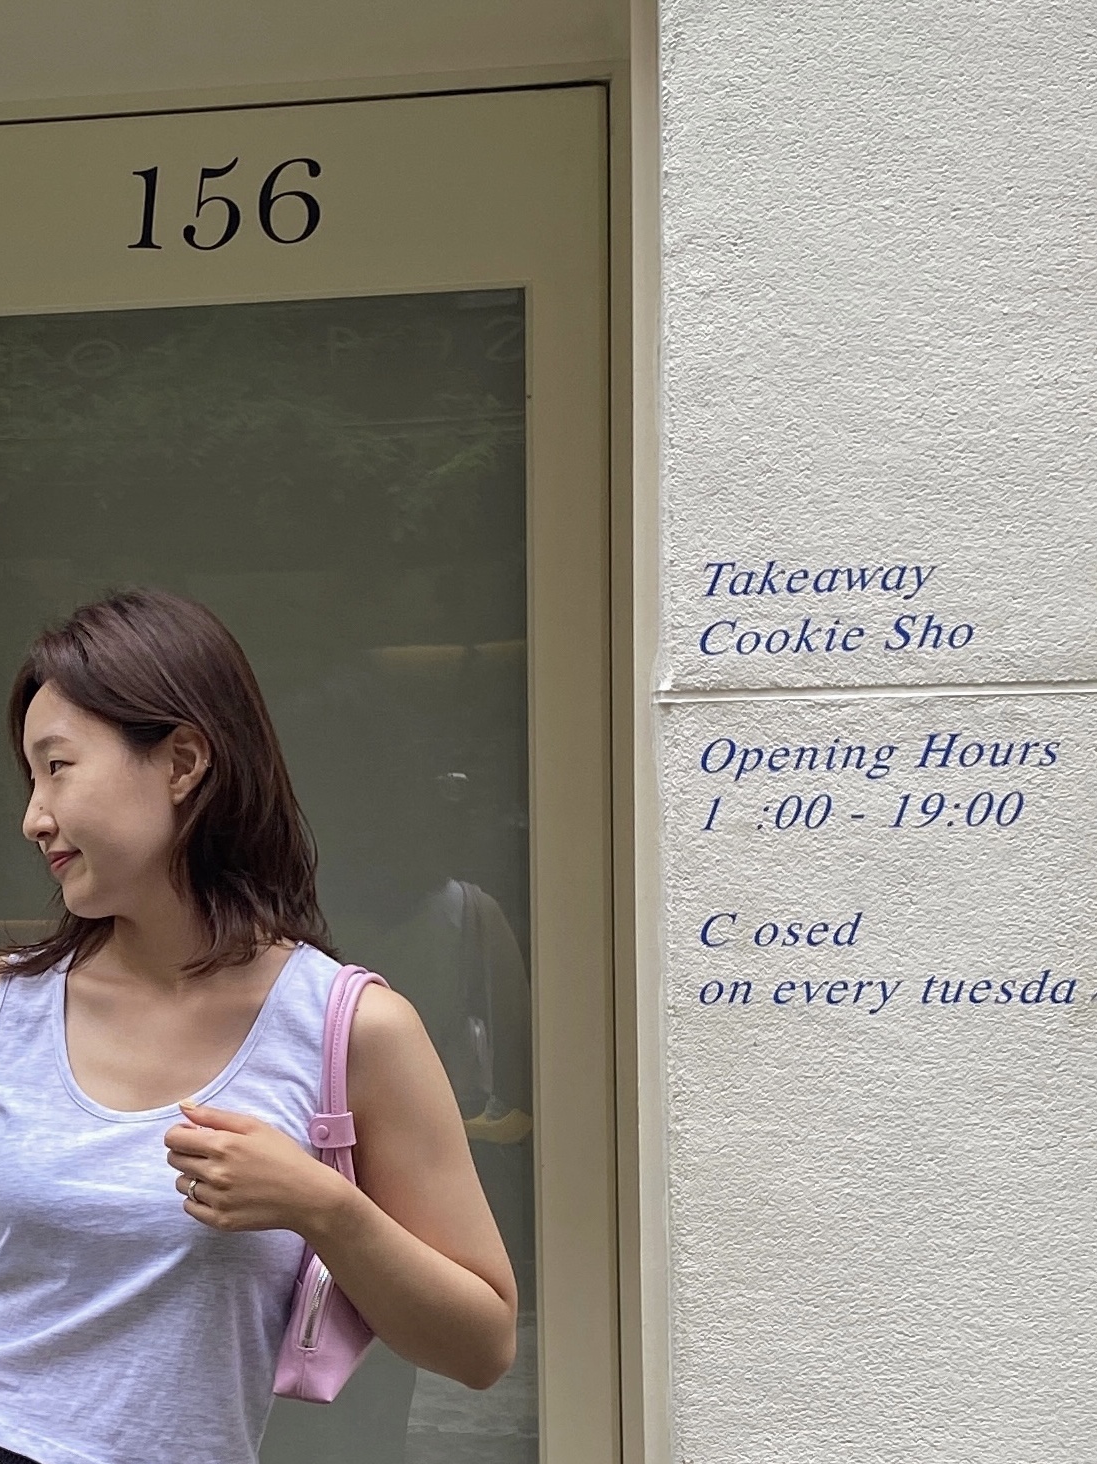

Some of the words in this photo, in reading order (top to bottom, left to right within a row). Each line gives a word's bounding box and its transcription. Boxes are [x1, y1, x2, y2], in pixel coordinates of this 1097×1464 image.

[127, 156, 322, 251] 156
[703, 560, 936, 599] Takeaway
[699, 618, 866, 655] Cookie
[700, 737, 899, 781] Opening
[915, 733, 1061, 769] Hours
[702, 794, 833, 830] 1:00
[889, 792, 1025, 829] 19:00
[699, 912, 863, 948] Cosed
[698, 979, 753, 1006] on
[772, 979, 904, 1015] every
[921, 970, 1097, 1007] tuesda
